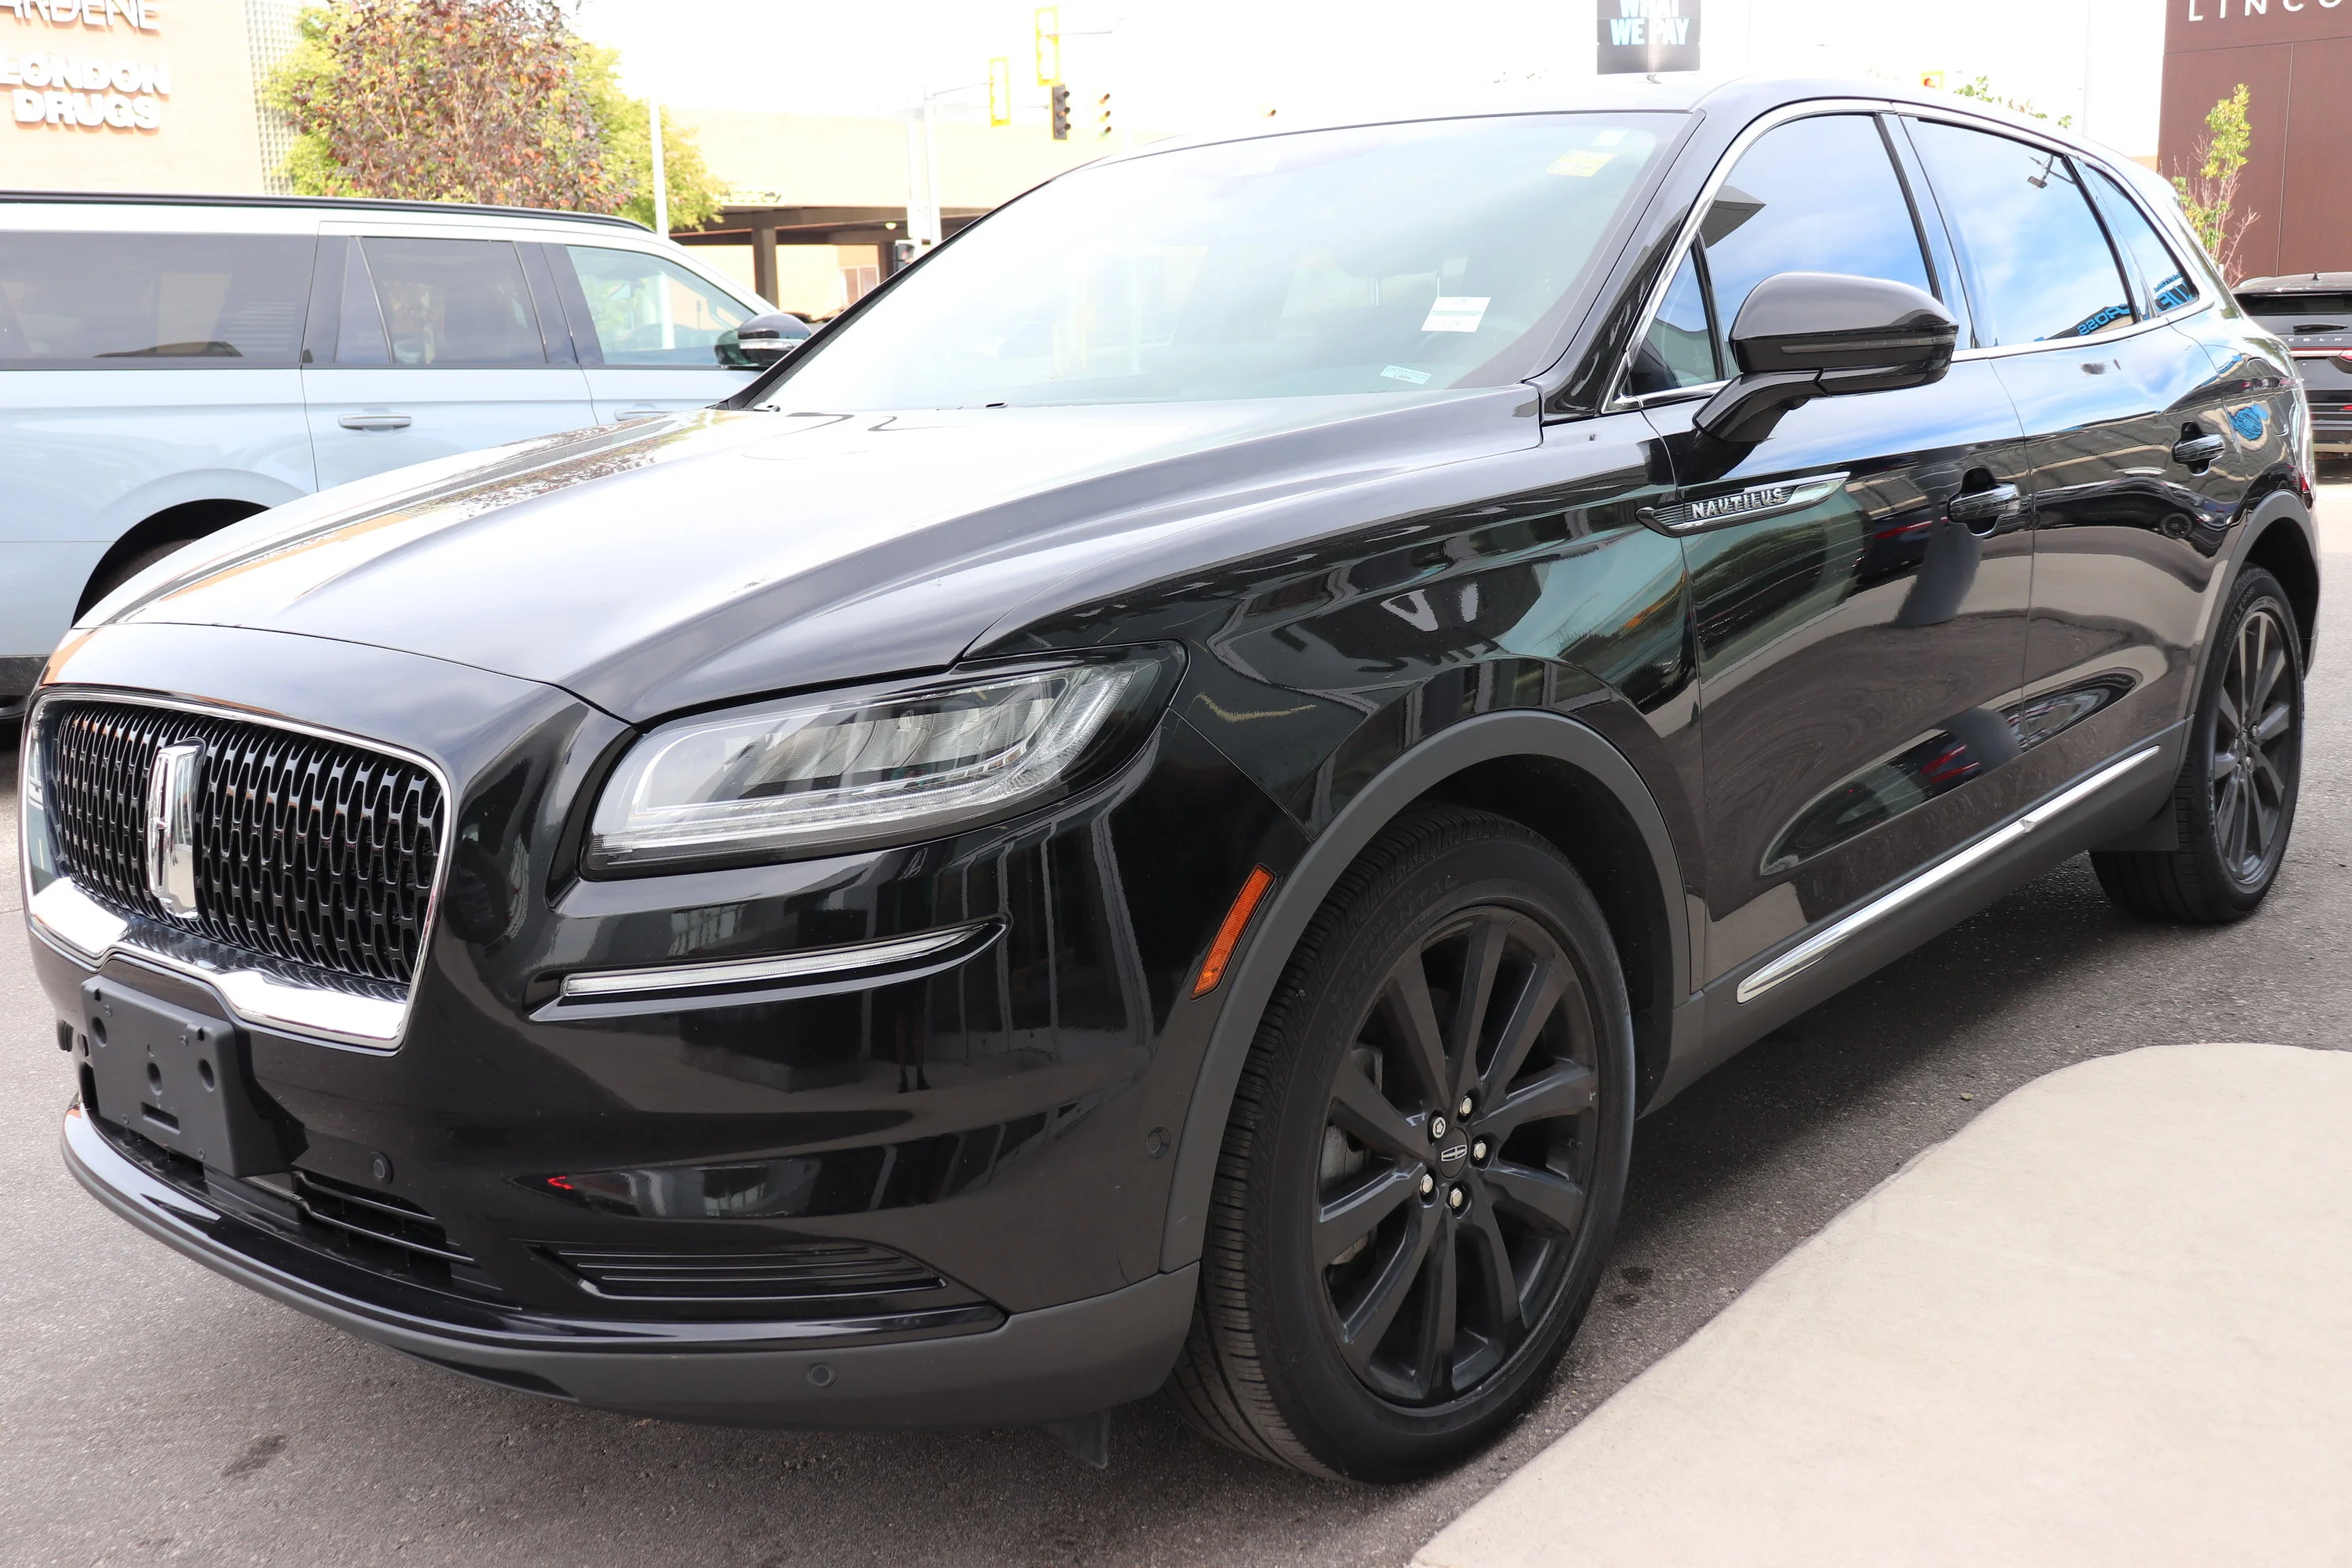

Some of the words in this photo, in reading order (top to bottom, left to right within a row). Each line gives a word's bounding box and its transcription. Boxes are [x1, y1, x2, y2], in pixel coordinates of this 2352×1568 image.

[1610, 18, 1645, 45] WE
[1648, 18, 1690, 45] PAY
[0, 51, 172, 96] LONDON
[13, 89, 161, 129] DRUGS
[1691, 488, 1785, 518] NAUTILUS
